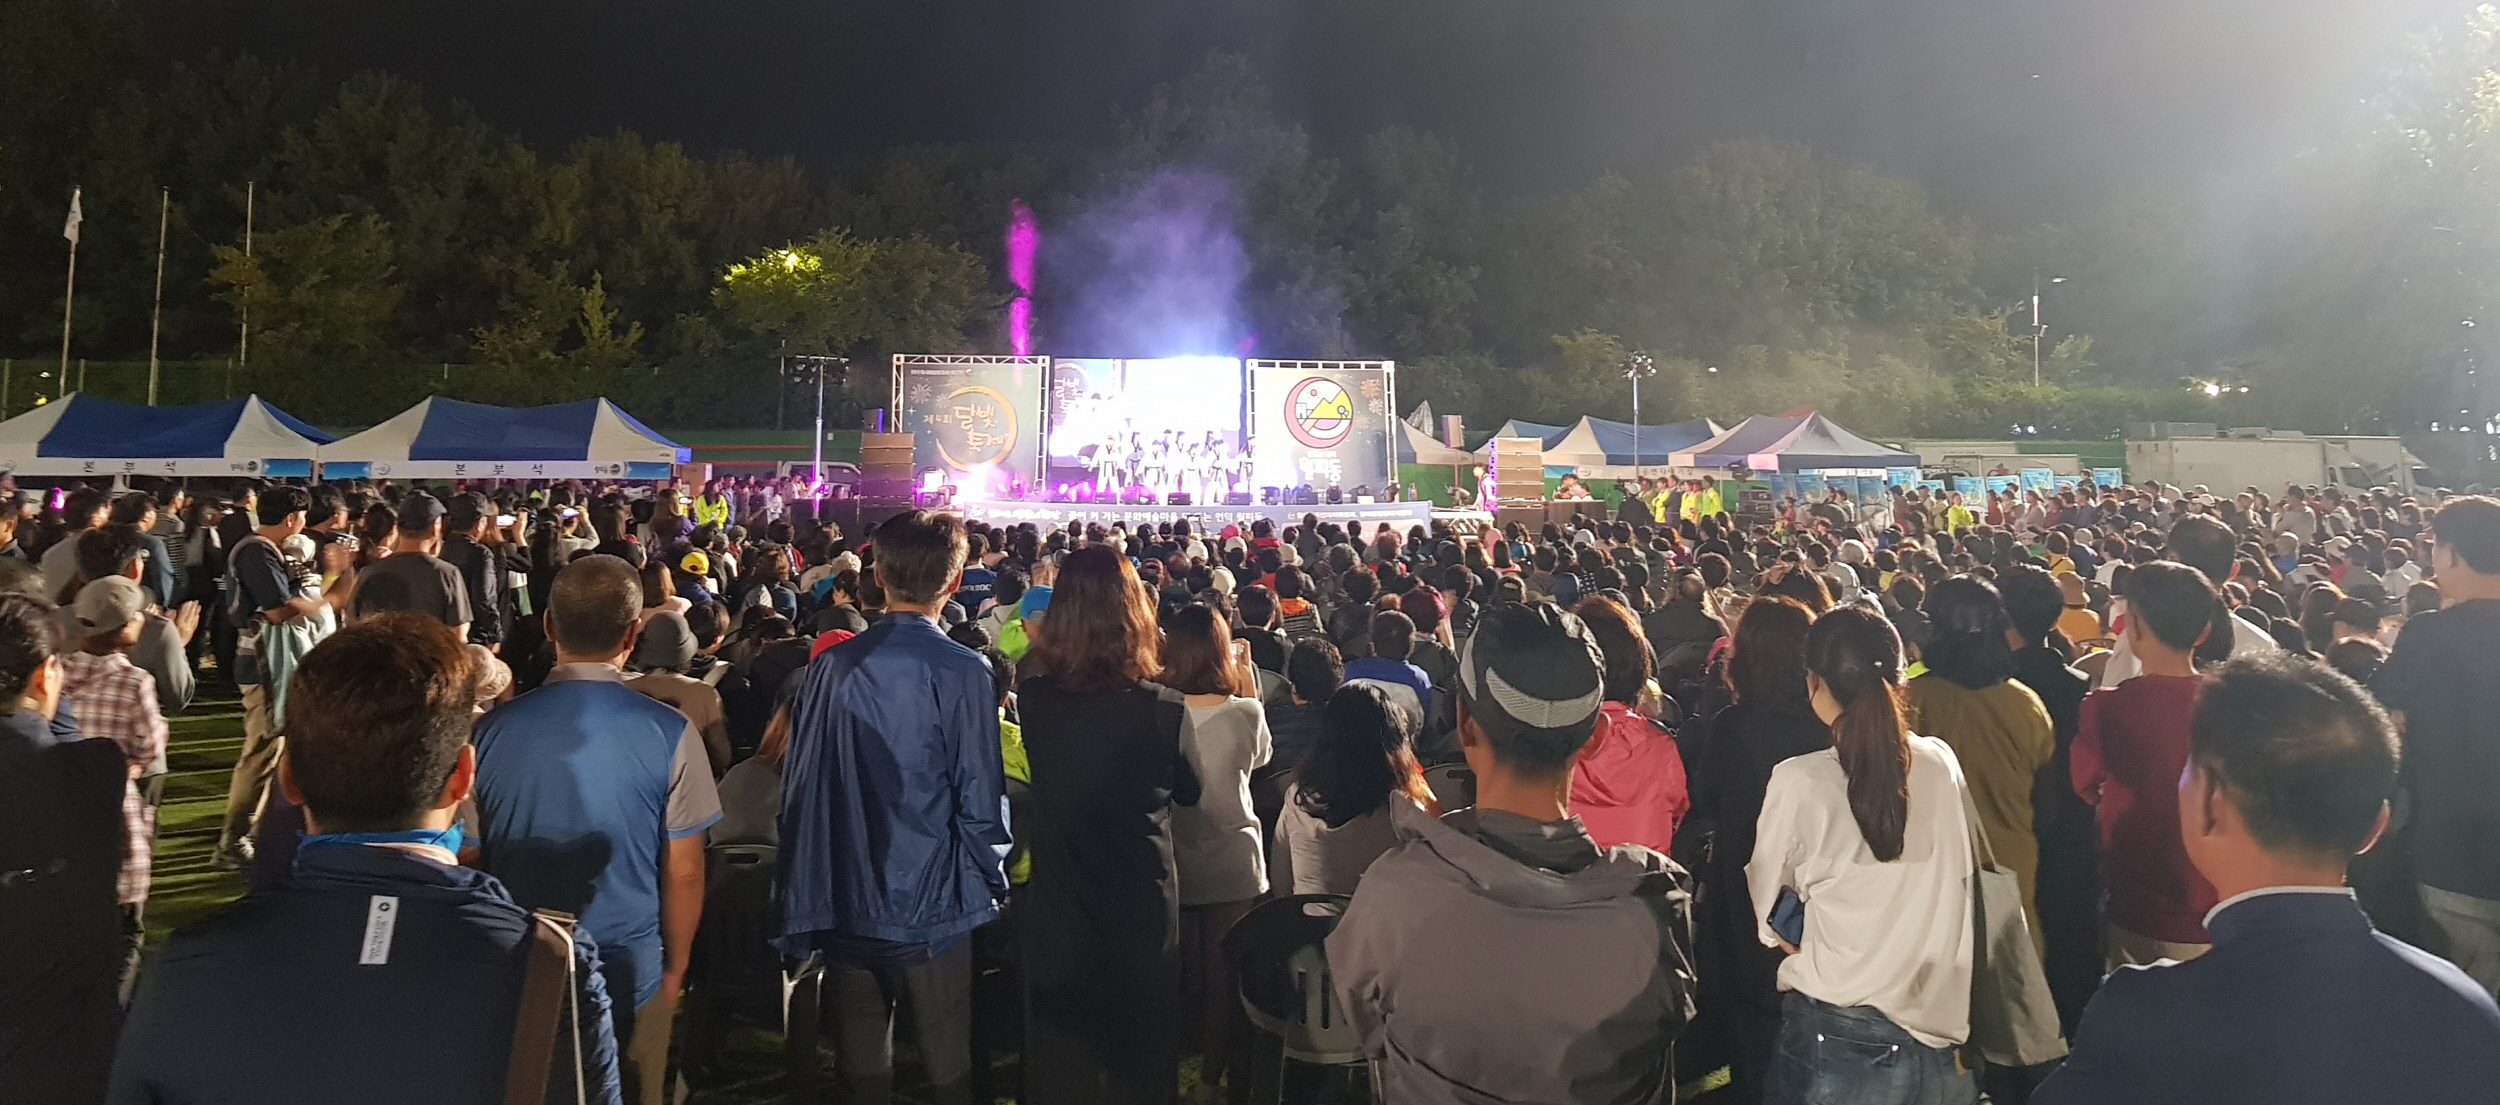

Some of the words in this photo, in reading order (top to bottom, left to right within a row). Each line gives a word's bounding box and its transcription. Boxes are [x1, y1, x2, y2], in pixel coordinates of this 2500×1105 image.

[953, 403, 998, 431] 달빛
[966, 427, 1004, 452] 축제
[1101, 511, 1121, 523] 가는
